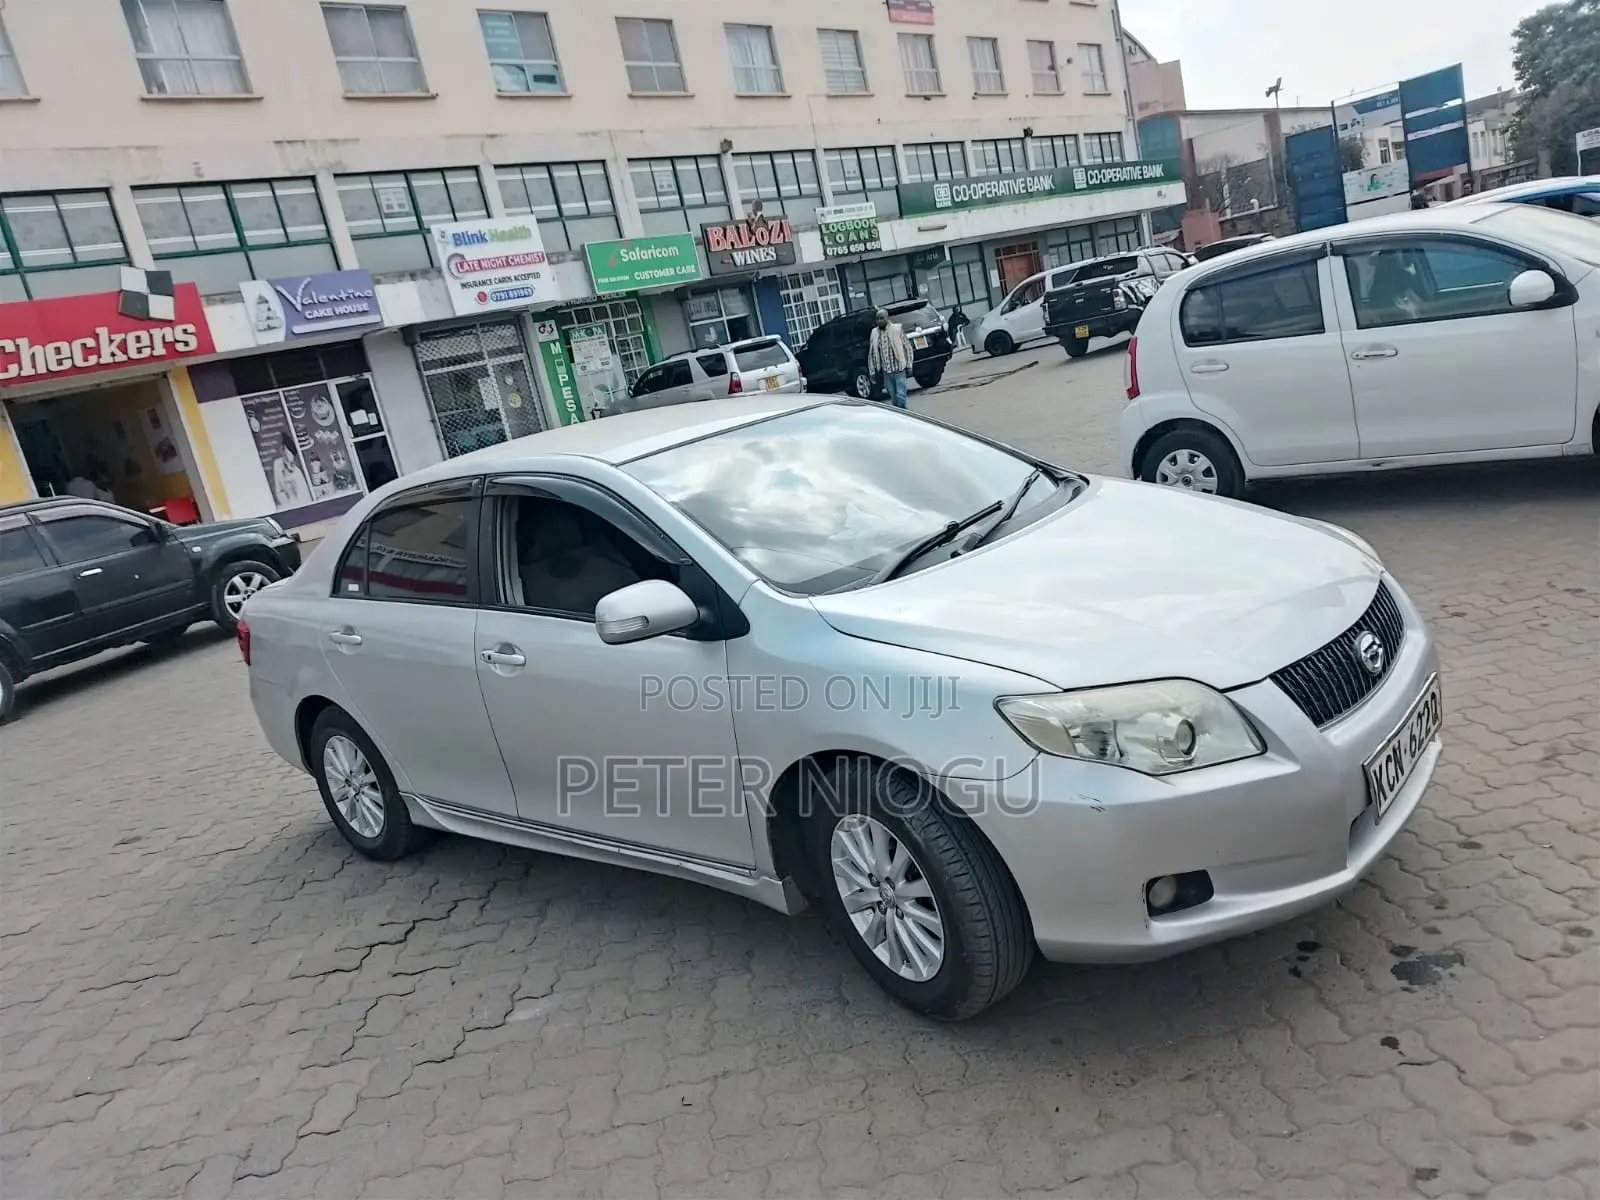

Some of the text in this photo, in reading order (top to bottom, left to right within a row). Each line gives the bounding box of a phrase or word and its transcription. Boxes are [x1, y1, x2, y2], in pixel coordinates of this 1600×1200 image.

[1142, 163, 1164, 179] BANK
[952, 174, 1055, 202] CO-OPERATIVE BANK
[452, 225, 532, 247] Blink Health
[707, 219, 792, 252] BALOZI
[821, 218, 877, 234] LOGBOOK
[823, 228, 878, 245] LOANS
[457, 252, 543, 273] LATE NIGHT CHEMIST
[619, 245, 679, 262] Safaricom
[731, 246, 776, 267] WINES
[460, 271, 541, 290] INSURANCE CARDS ACCEPTED
[634, 268, 675, 281] CUSTOMER
[676, 264, 696, 275] CARE
[275, 277, 374, 312] Valentine
[304, 302, 370, 320] CAKE HOUSE
[0, 323, 198, 380] Checkers
